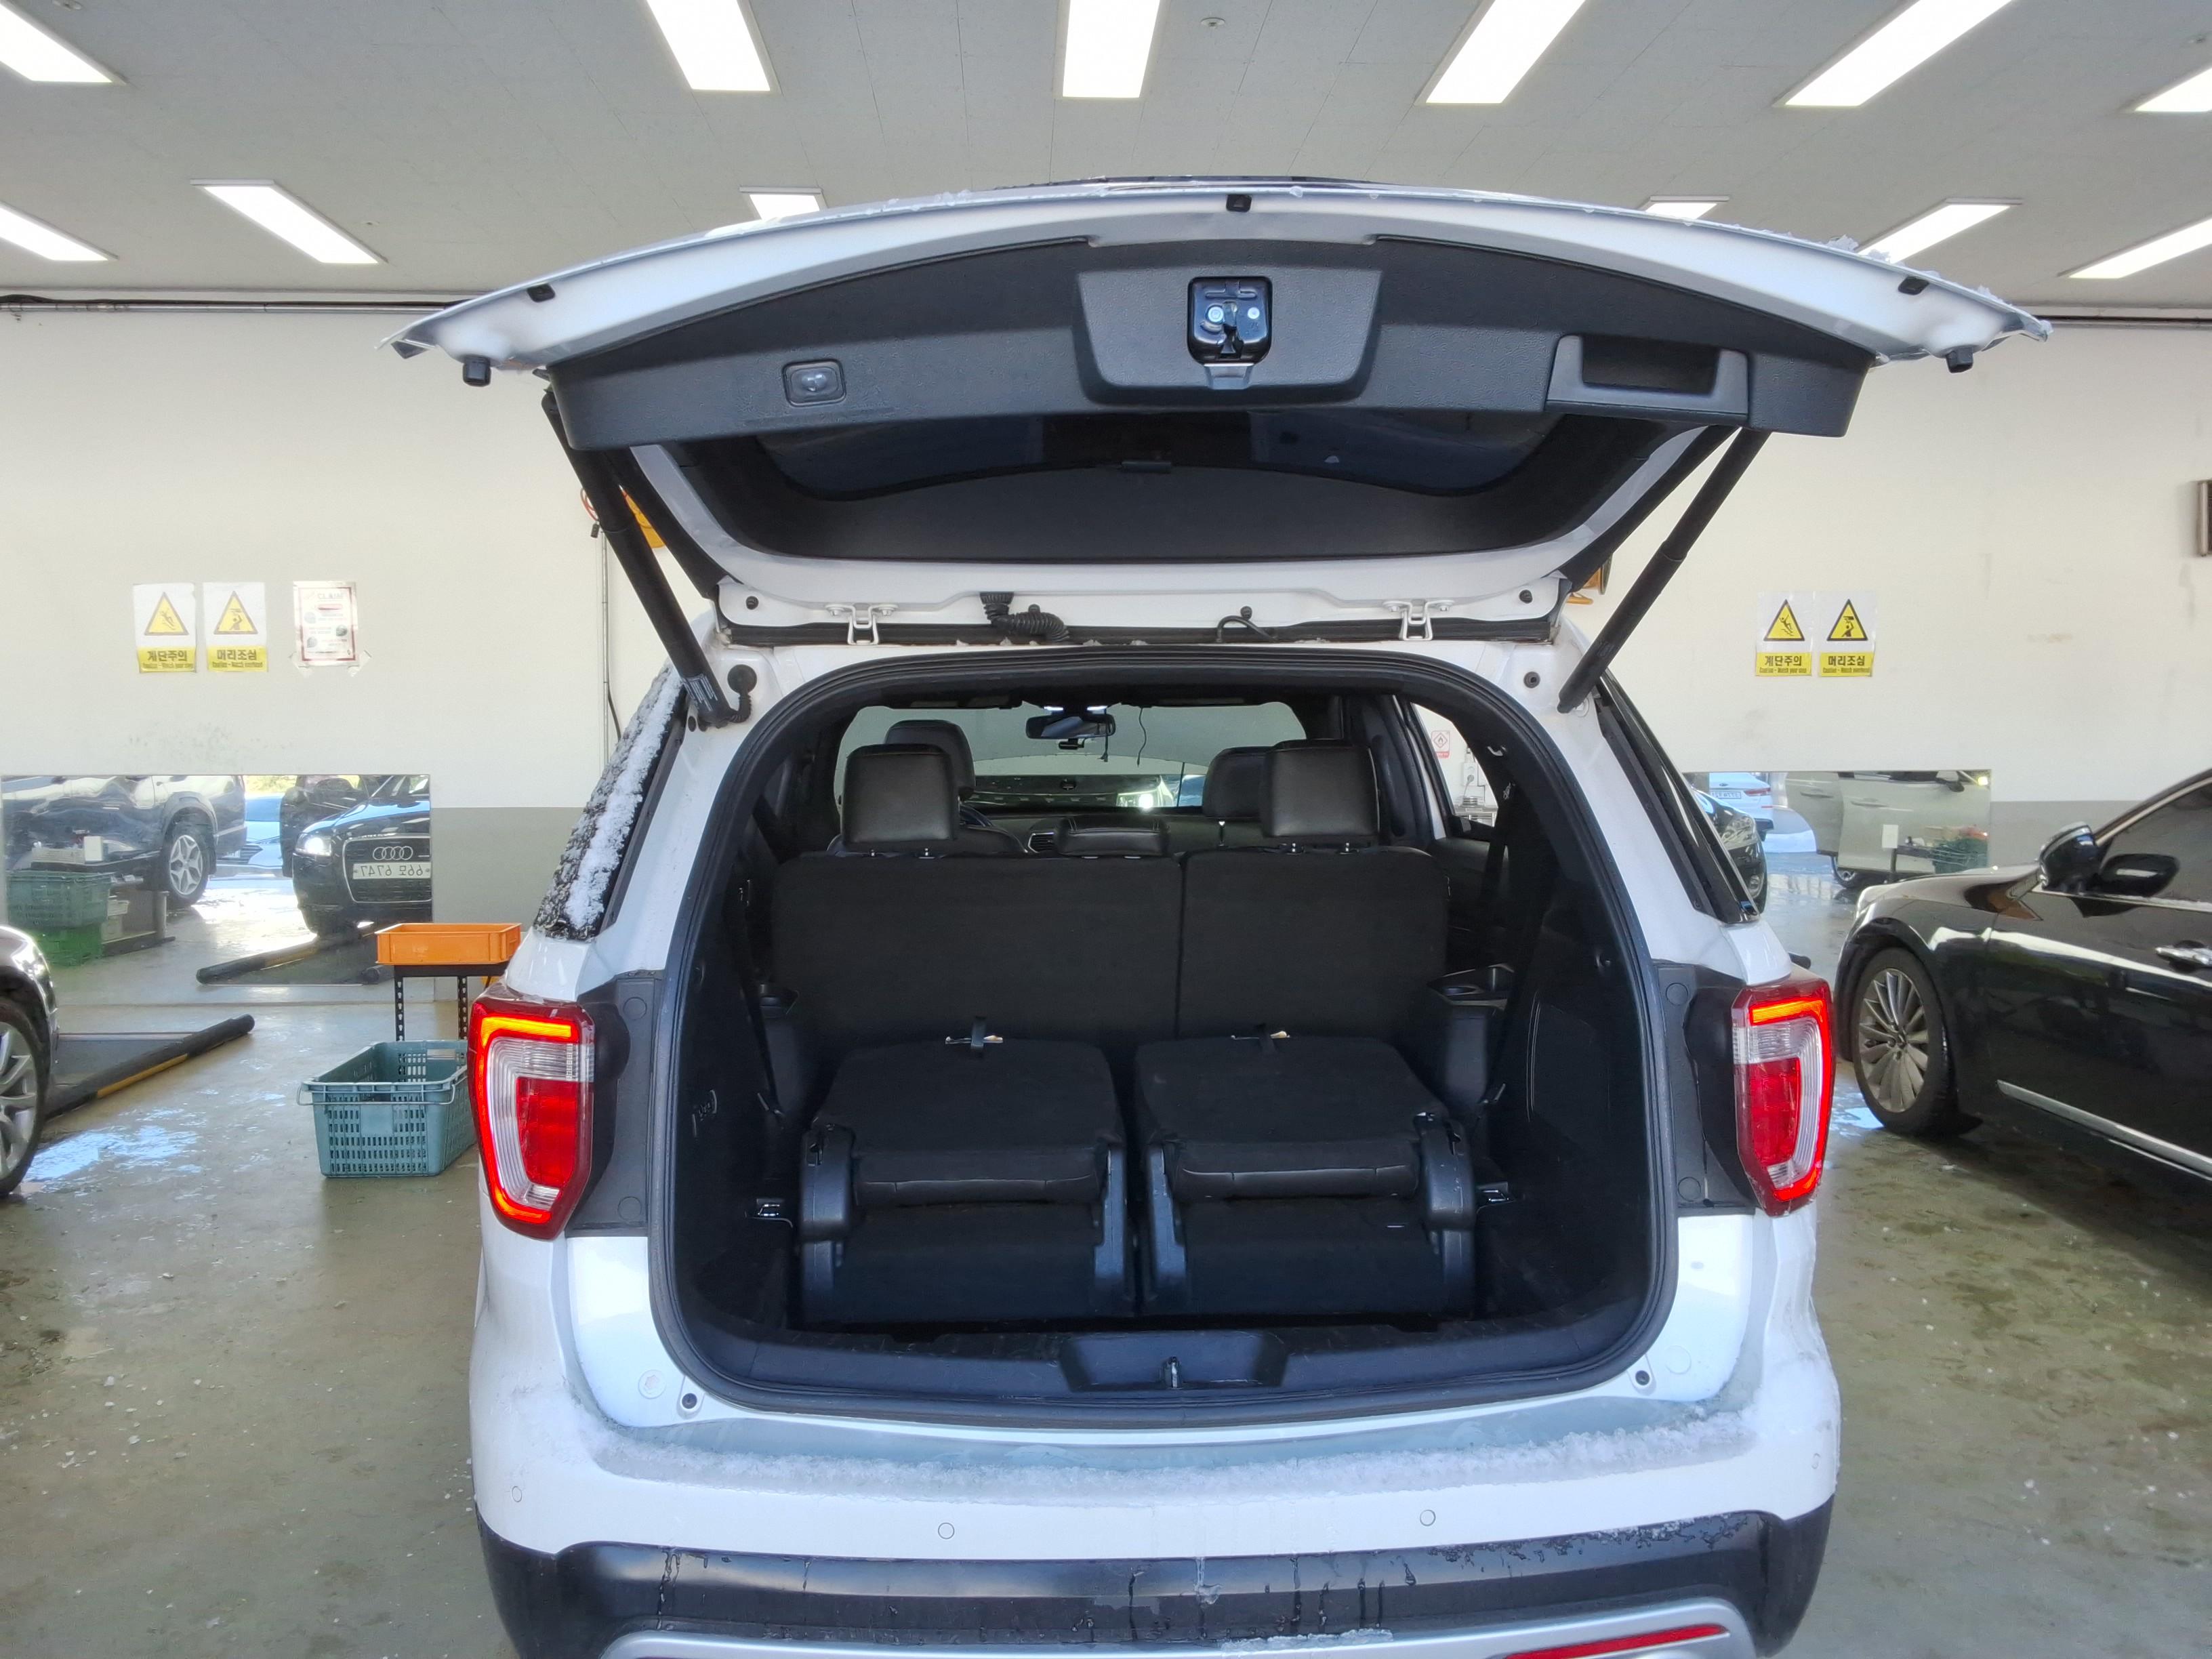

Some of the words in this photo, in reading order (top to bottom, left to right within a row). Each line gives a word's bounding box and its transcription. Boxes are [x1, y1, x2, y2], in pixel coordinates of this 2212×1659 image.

[148, 650, 188, 661] 계단주의
[217, 649, 257, 660] 머리조심
[1764, 655, 1802, 666] 계단주의
[1828, 655, 1865, 666] 머리조심
